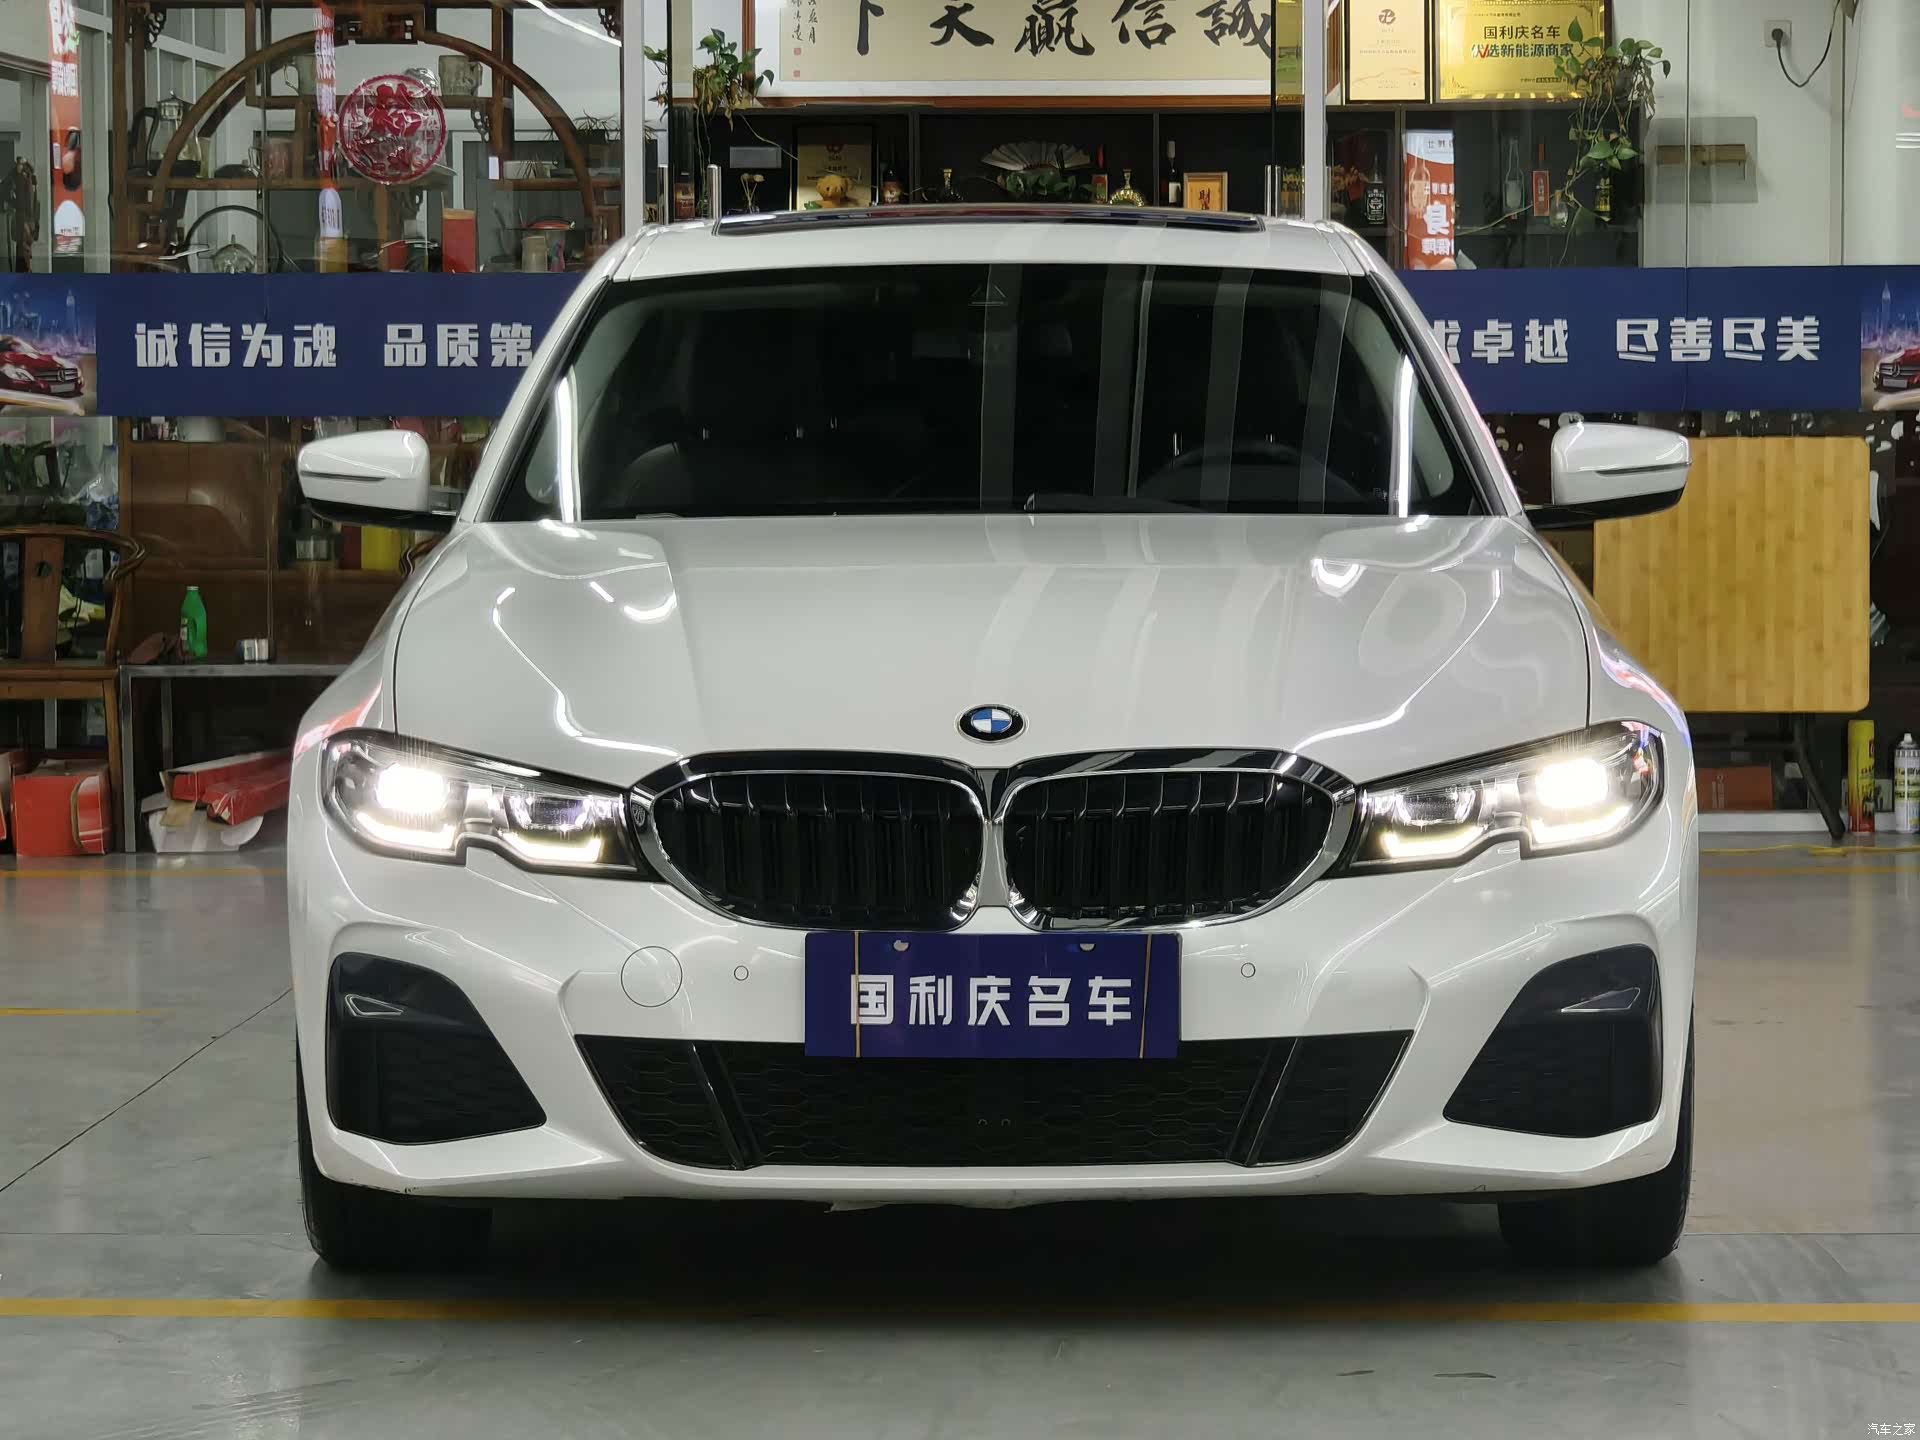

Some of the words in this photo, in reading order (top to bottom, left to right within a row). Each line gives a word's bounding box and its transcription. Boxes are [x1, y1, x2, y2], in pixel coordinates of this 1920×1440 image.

[1483, 25, 1561, 40] 国利庆名车
[135, 322, 337, 368] 诚信为魂
[384, 322, 533, 367] 品质第
[1616, 316, 1821, 363] 尽善尽美
[851, 974, 1132, 1026] 国利庆名车
